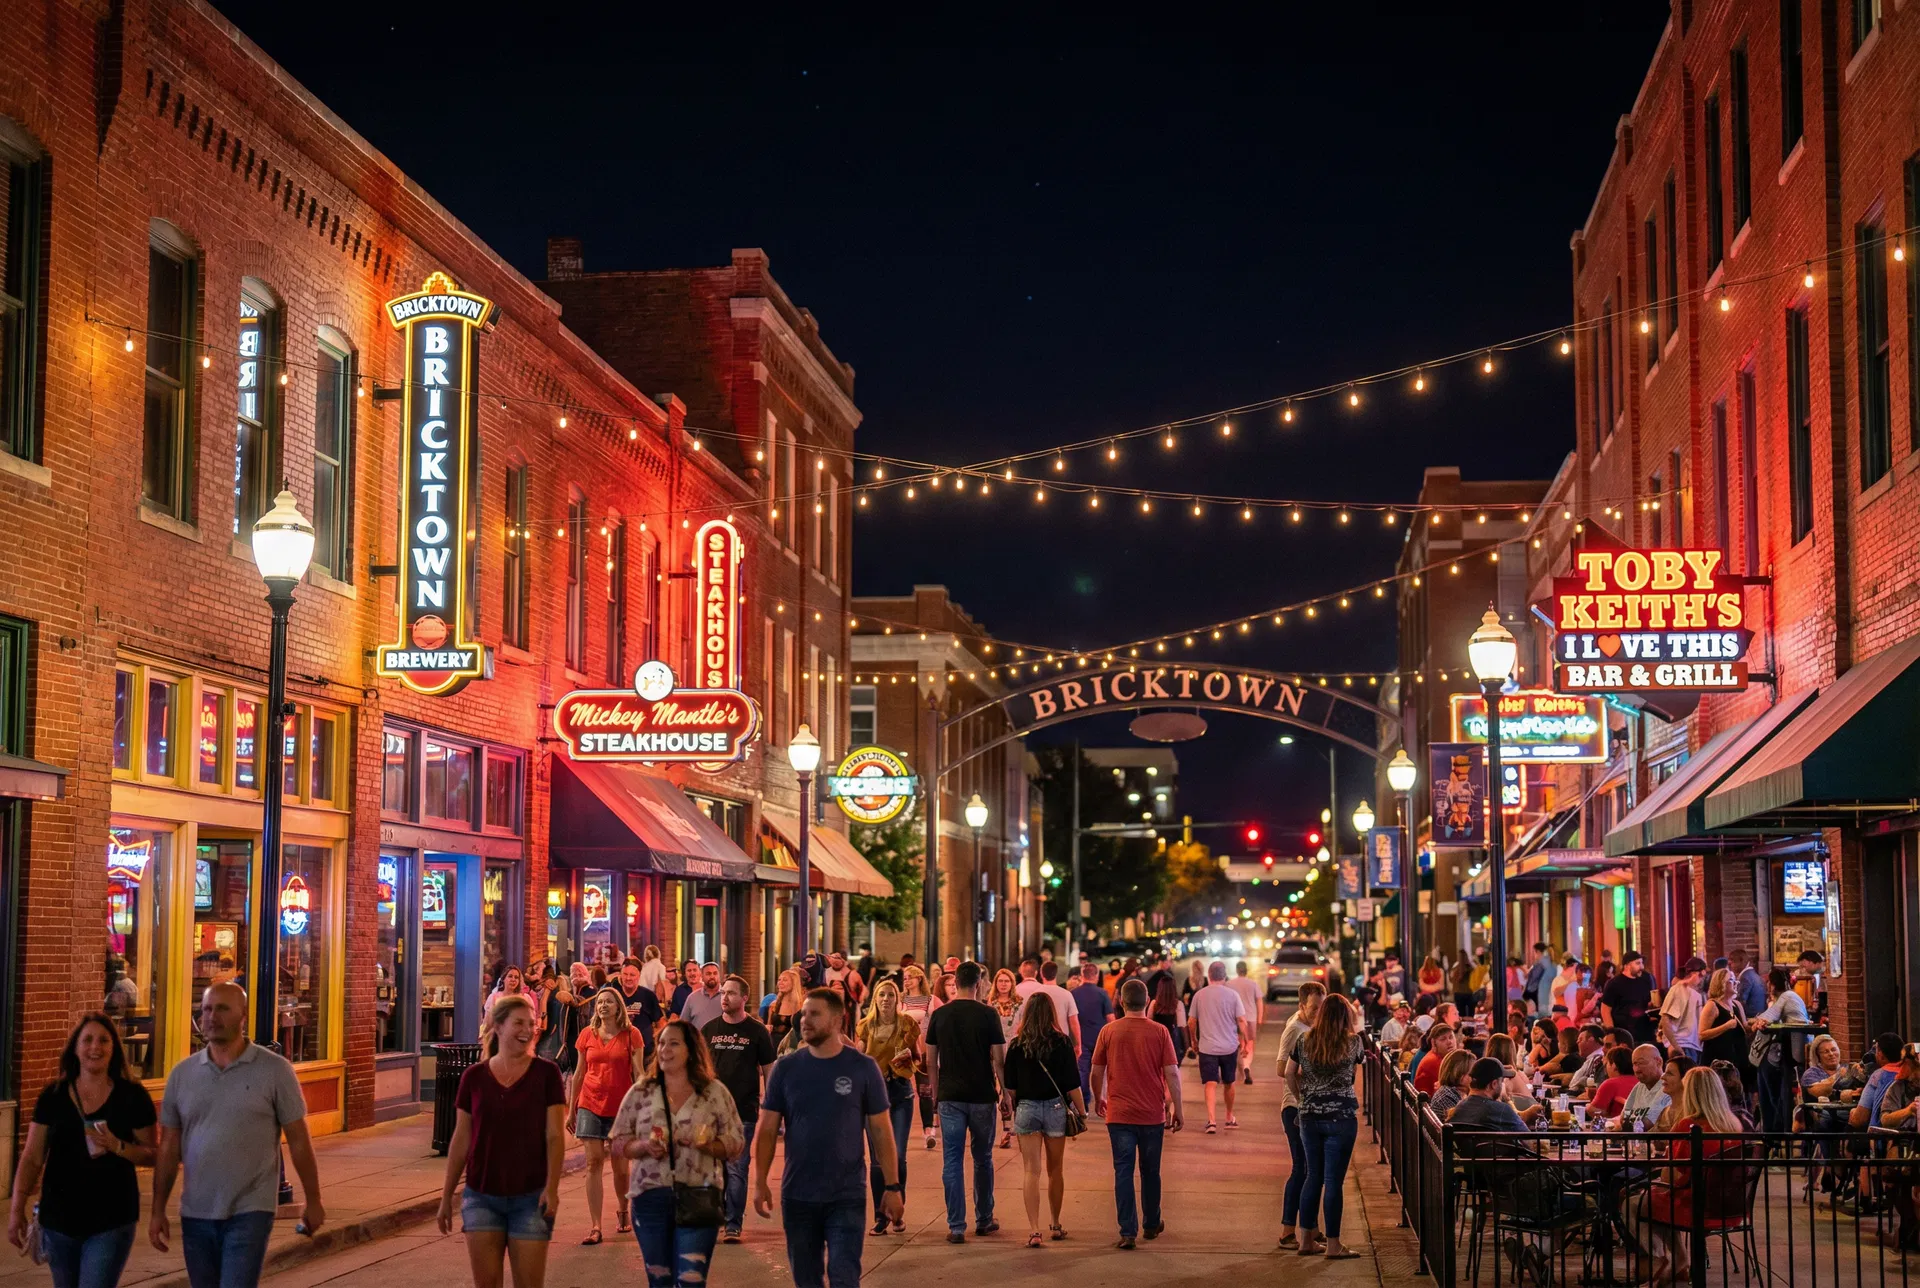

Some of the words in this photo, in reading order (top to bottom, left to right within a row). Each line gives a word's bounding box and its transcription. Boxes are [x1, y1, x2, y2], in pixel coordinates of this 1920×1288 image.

[392, 295, 482, 321] BRICKTOWN
[414, 326, 452, 608] BRICKTOWN
[1578, 551, 1721, 591] TOBY
[706, 533, 726, 688] STEAKHOUS
[1560, 593, 1742, 629] KEITH'S
[386, 652, 473, 668] BREWERY
[1564, 633, 1577, 659] I
[1667, 633, 1740, 659] THIS
[1567, 665, 1624, 687] BAR
[1629, 664, 1651, 687] &
[1655, 664, 1738, 686] GRILL
[1029, 669, 1308, 720] BRICKTOWN
[569, 701, 646, 732] Mickey
[652, 701, 740, 725] Mantle's
[580, 732, 728, 752] STEAKHOUSE
